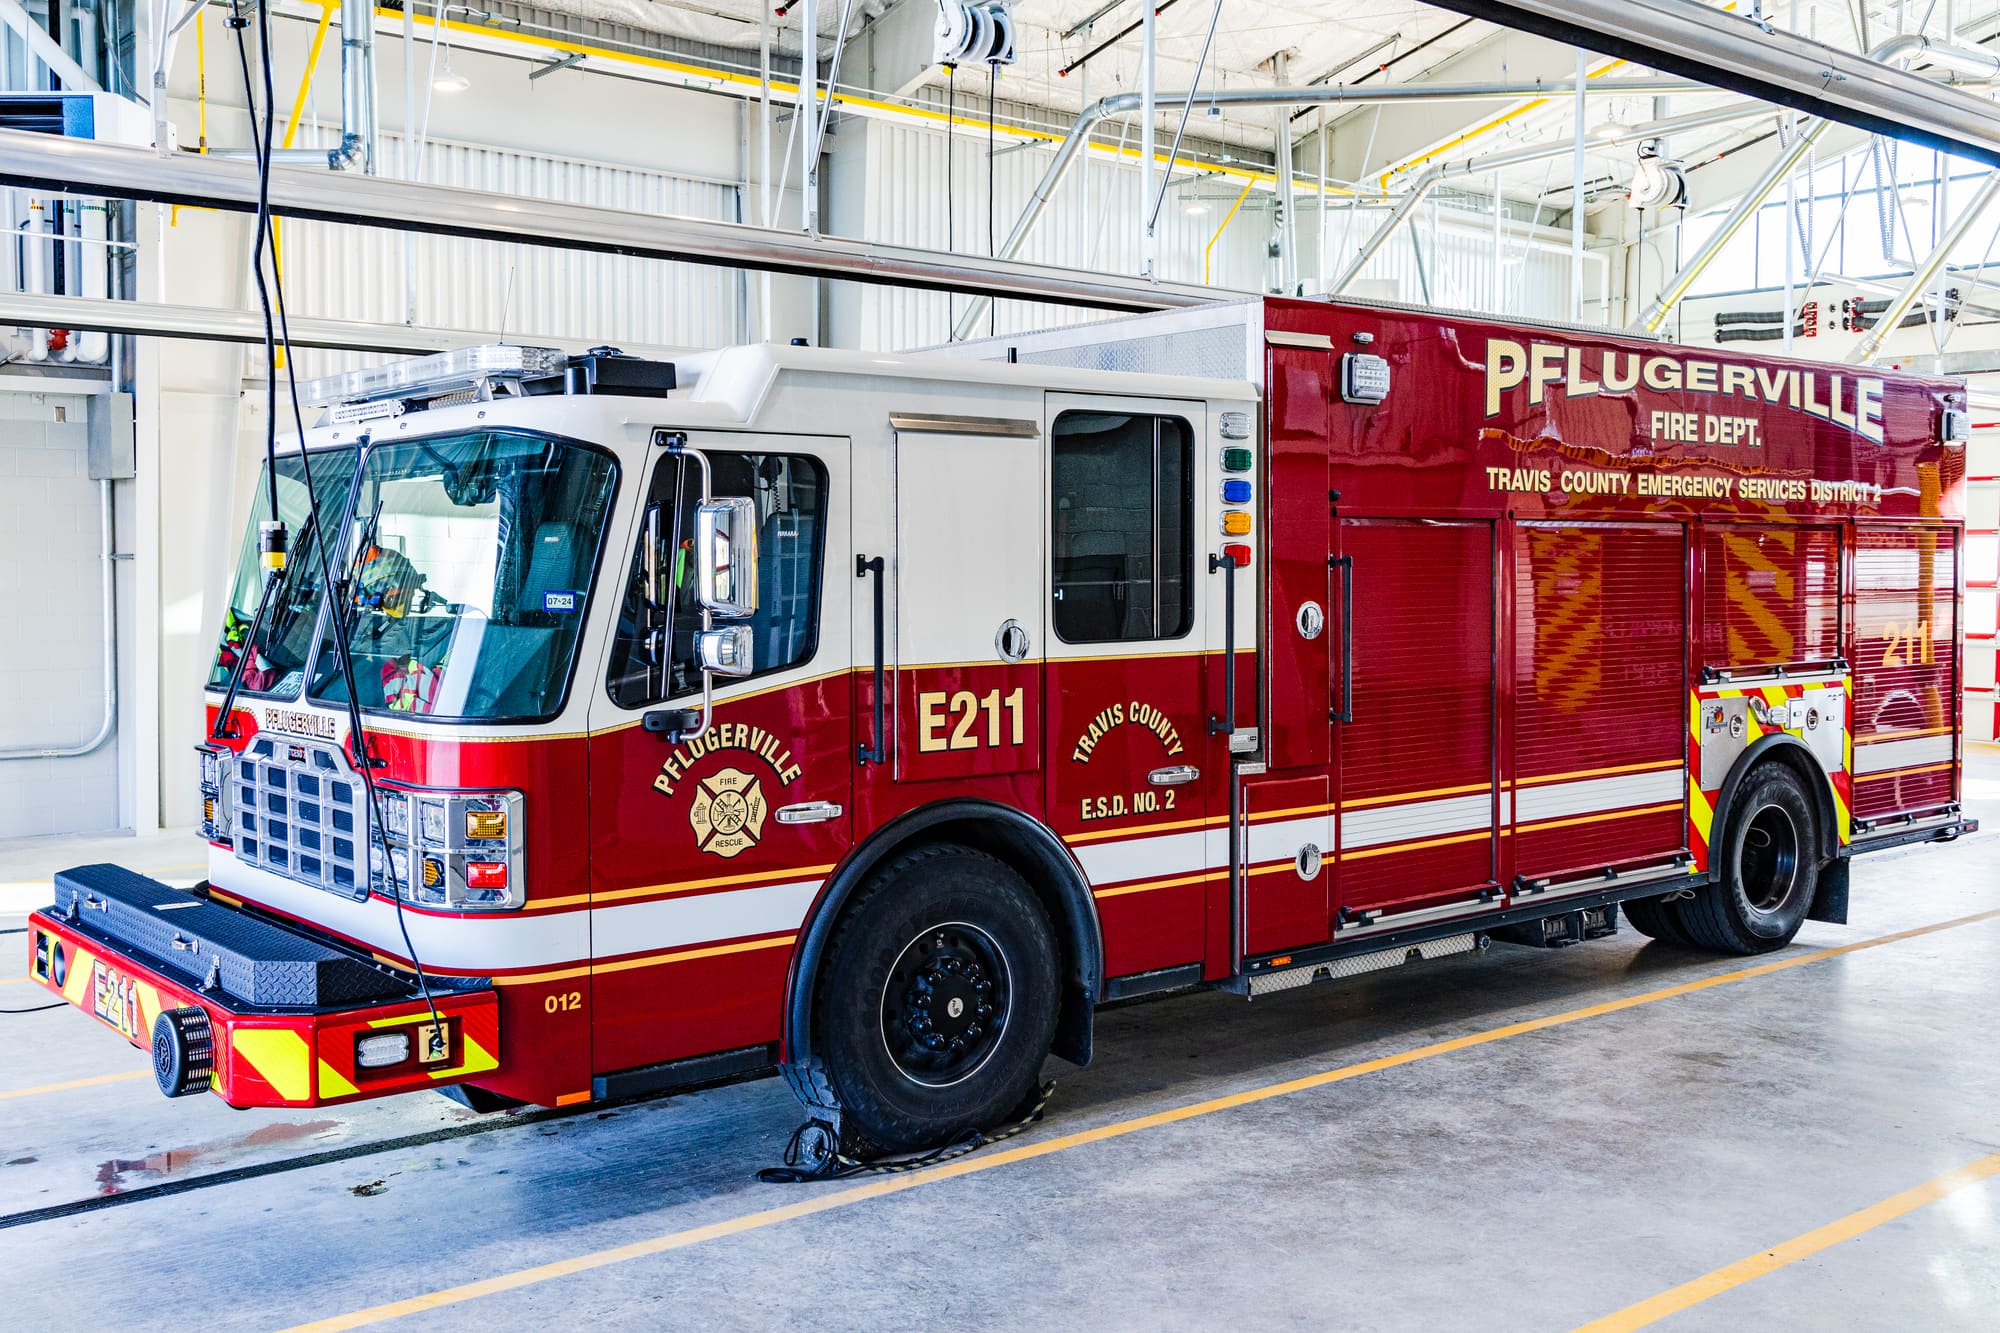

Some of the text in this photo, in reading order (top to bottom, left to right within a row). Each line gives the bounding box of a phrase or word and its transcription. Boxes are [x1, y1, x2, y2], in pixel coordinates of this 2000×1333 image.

[1485, 338, 1885, 446] PFLUGERVILLE
[1650, 410, 1761, 447] FIRE DEPT.
[1486, 467, 1882, 503] TRAVIS COUNTY EMERGENCY SERVICES DISTRICT 2
[547, 597, 572, 606] 07-24
[1882, 619, 1928, 667] 211
[265, 708, 336, 740] PFLUGERVILLE
[918, 687, 1024, 754] E211
[1072, 701, 1184, 765] TRAVIS COUNTY
[652, 723, 803, 798] PFLUGERVILLE
[719, 777, 738, 786] FIRE
[1081, 789, 1176, 820] E.S.D. NO. 2
[715, 838, 744, 848] RESCUE
[94, 958, 138, 1038] E211
[544, 991, 582, 1014] 012
